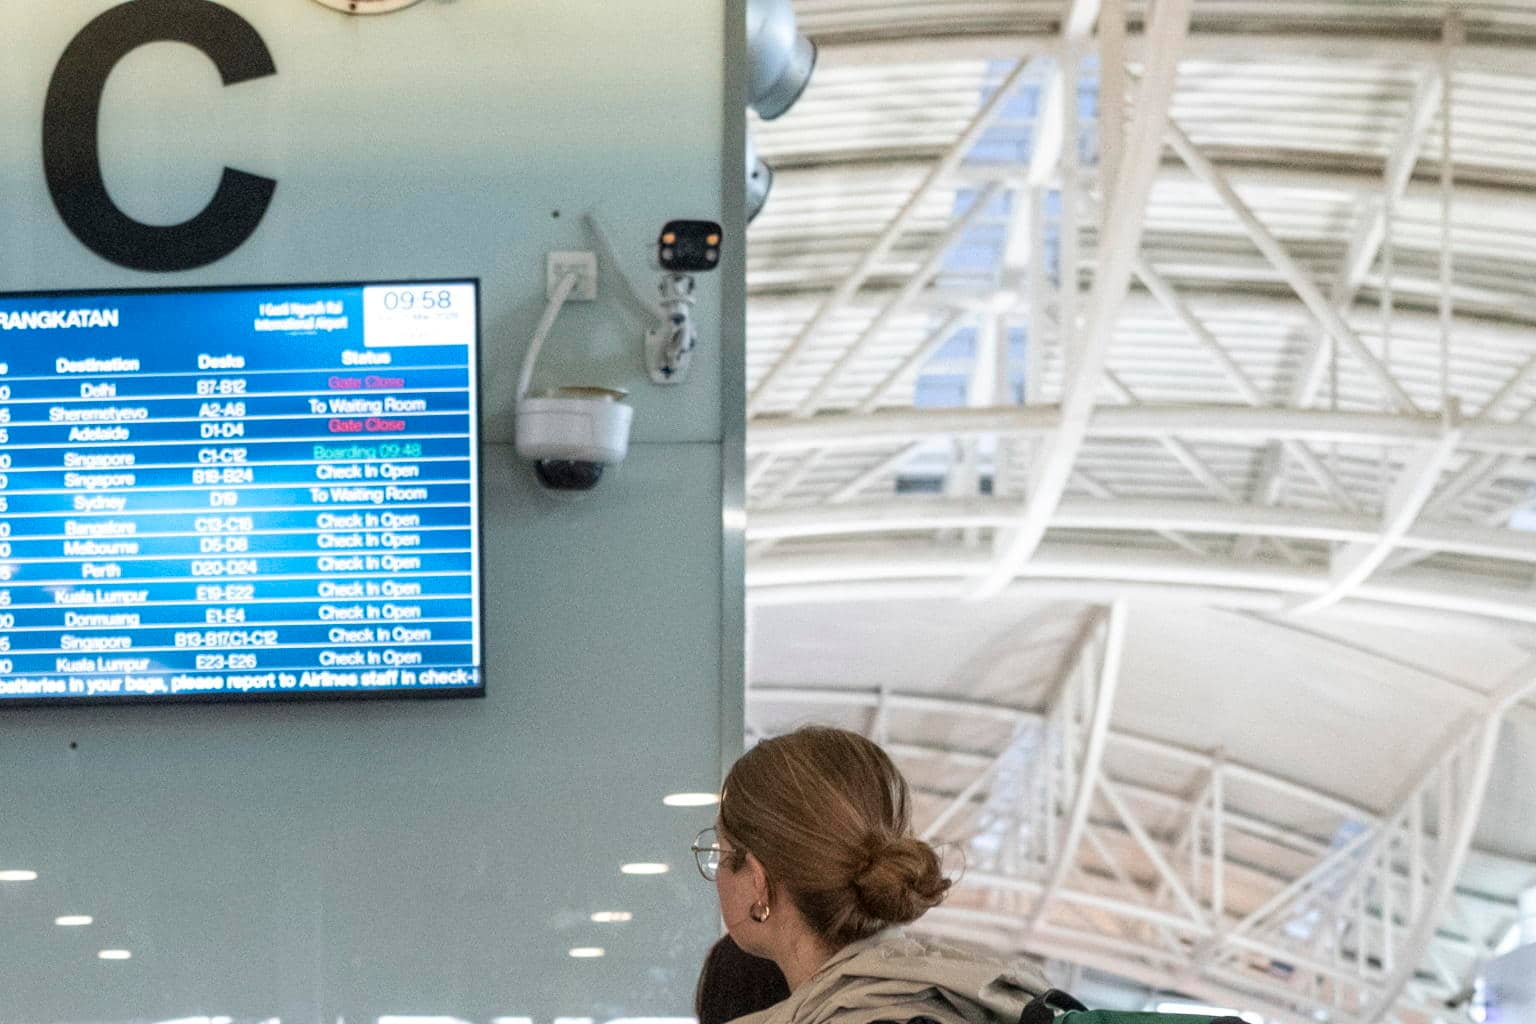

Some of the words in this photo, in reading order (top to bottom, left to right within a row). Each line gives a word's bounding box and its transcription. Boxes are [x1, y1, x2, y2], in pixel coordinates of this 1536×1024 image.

[42, 0, 277, 272] C
[56, 358, 140, 373] Destination
[341, 351, 391, 365] Status
[328, 376, 360, 389] Gate
[366, 375, 404, 388] Close
[81, 383, 116, 398] Delhi
[309, 400, 326, 413] To
[329, 400, 382, 415] Waiting
[385, 398, 426, 412] Room
[49, 407, 148, 422] Sheremetyevo
[329, 419, 362, 432] Gate
[366, 418, 405, 431] Close
[69, 427, 129, 441] Adelaide
[64, 453, 135, 467] Singapore
[314, 445, 376, 460] Boarding
[317, 465, 363, 480] Check
[365, 464, 378, 479] In
[381, 463, 419, 480] Open
[64, 473, 136, 488] Singapore
[310, 489, 327, 503] To
[329, 489, 383, 504] Waiting
[385, 486, 427, 501] Room
[73, 496, 126, 511] Sydney
[317, 514, 363, 529] Check
[365, 514, 378, 528] In
[381, 512, 419, 529] Open
[317, 534, 363, 550] Check
[366, 533, 378, 548] In
[381, 532, 420, 549] Open
[64, 542, 138, 556] Melbourne
[82, 564, 121, 578] Perth
[317, 557, 363, 572] Check
[366, 556, 378, 571] In
[381, 555, 420, 572] Open
[54, 590, 93, 604] Kuala
[96, 589, 148, 604] Lumpur
[318, 583, 364, 599] Check
[366, 583, 379, 597] In
[382, 581, 421, 599] Open
[65, 612, 140, 627] Donmuang
[319, 606, 365, 622] Check
[367, 605, 380, 619] In
[382, 604, 421, 621] Open
[329, 629, 374, 643] Check
[376, 628, 389, 641] In
[392, 626, 430, 644] Open
[61, 636, 131, 650] Singapore
[319, 652, 366, 667] Check
[367, 651, 381, 665] In
[383, 649, 422, 666] Open
[56, 660, 94, 673] Kuala
[97, 658, 149, 674] Lumpur
[69, 675, 85, 692] in
[86, 677, 123, 695] your
[171, 671, 224, 692] please
[227, 671, 276, 690] report
[279, 671, 296, 688] to
[299, 668, 358, 688] Airlines
[361, 667, 397, 686] staff
[401, 669, 416, 685] in
